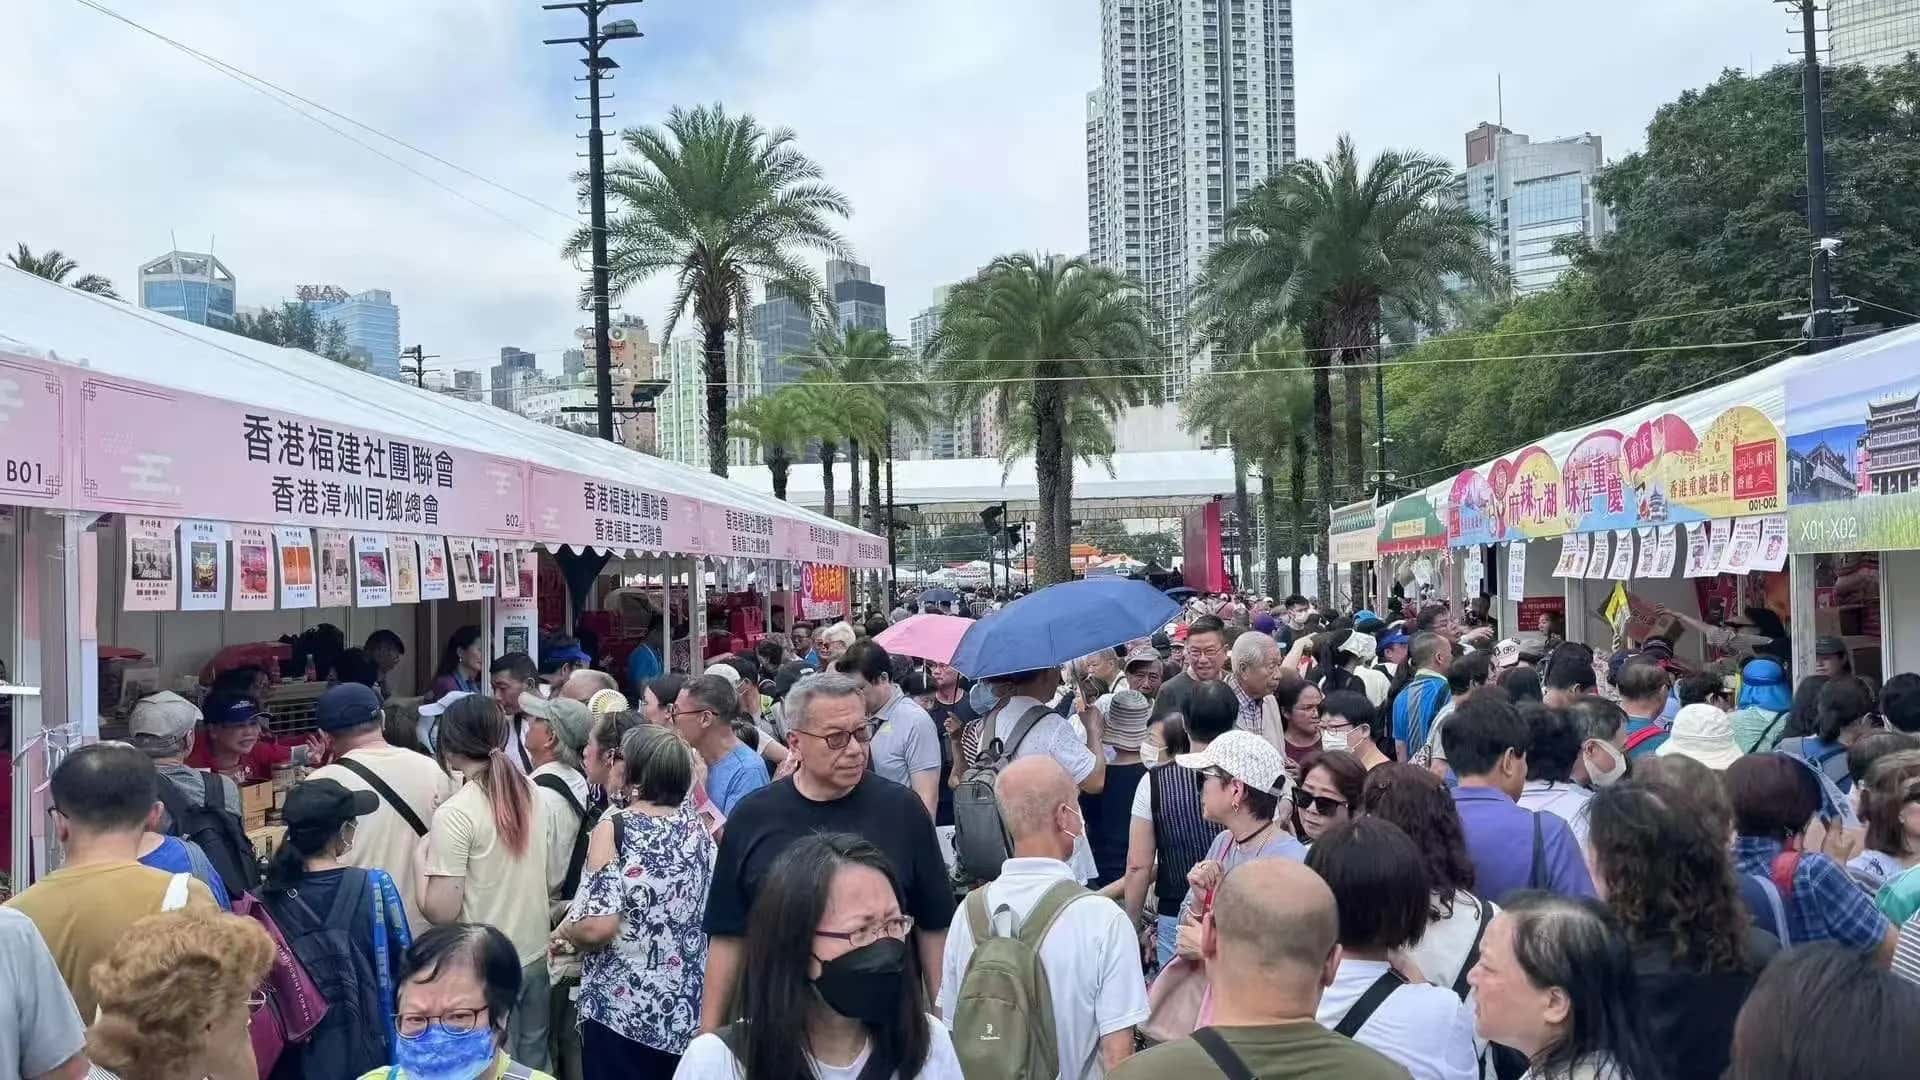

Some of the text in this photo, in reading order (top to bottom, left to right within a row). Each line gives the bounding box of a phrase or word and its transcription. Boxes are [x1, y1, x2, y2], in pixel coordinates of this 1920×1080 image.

[243, 413, 453, 489] 香港福建社團聯會
[6, 459, 42, 485] B01
[271, 475, 439, 526] 香港漳州同鄉總會
[583, 481, 669, 521] 香港福建社團聯會
[1800, 517, 1857, 541] X01-X02
